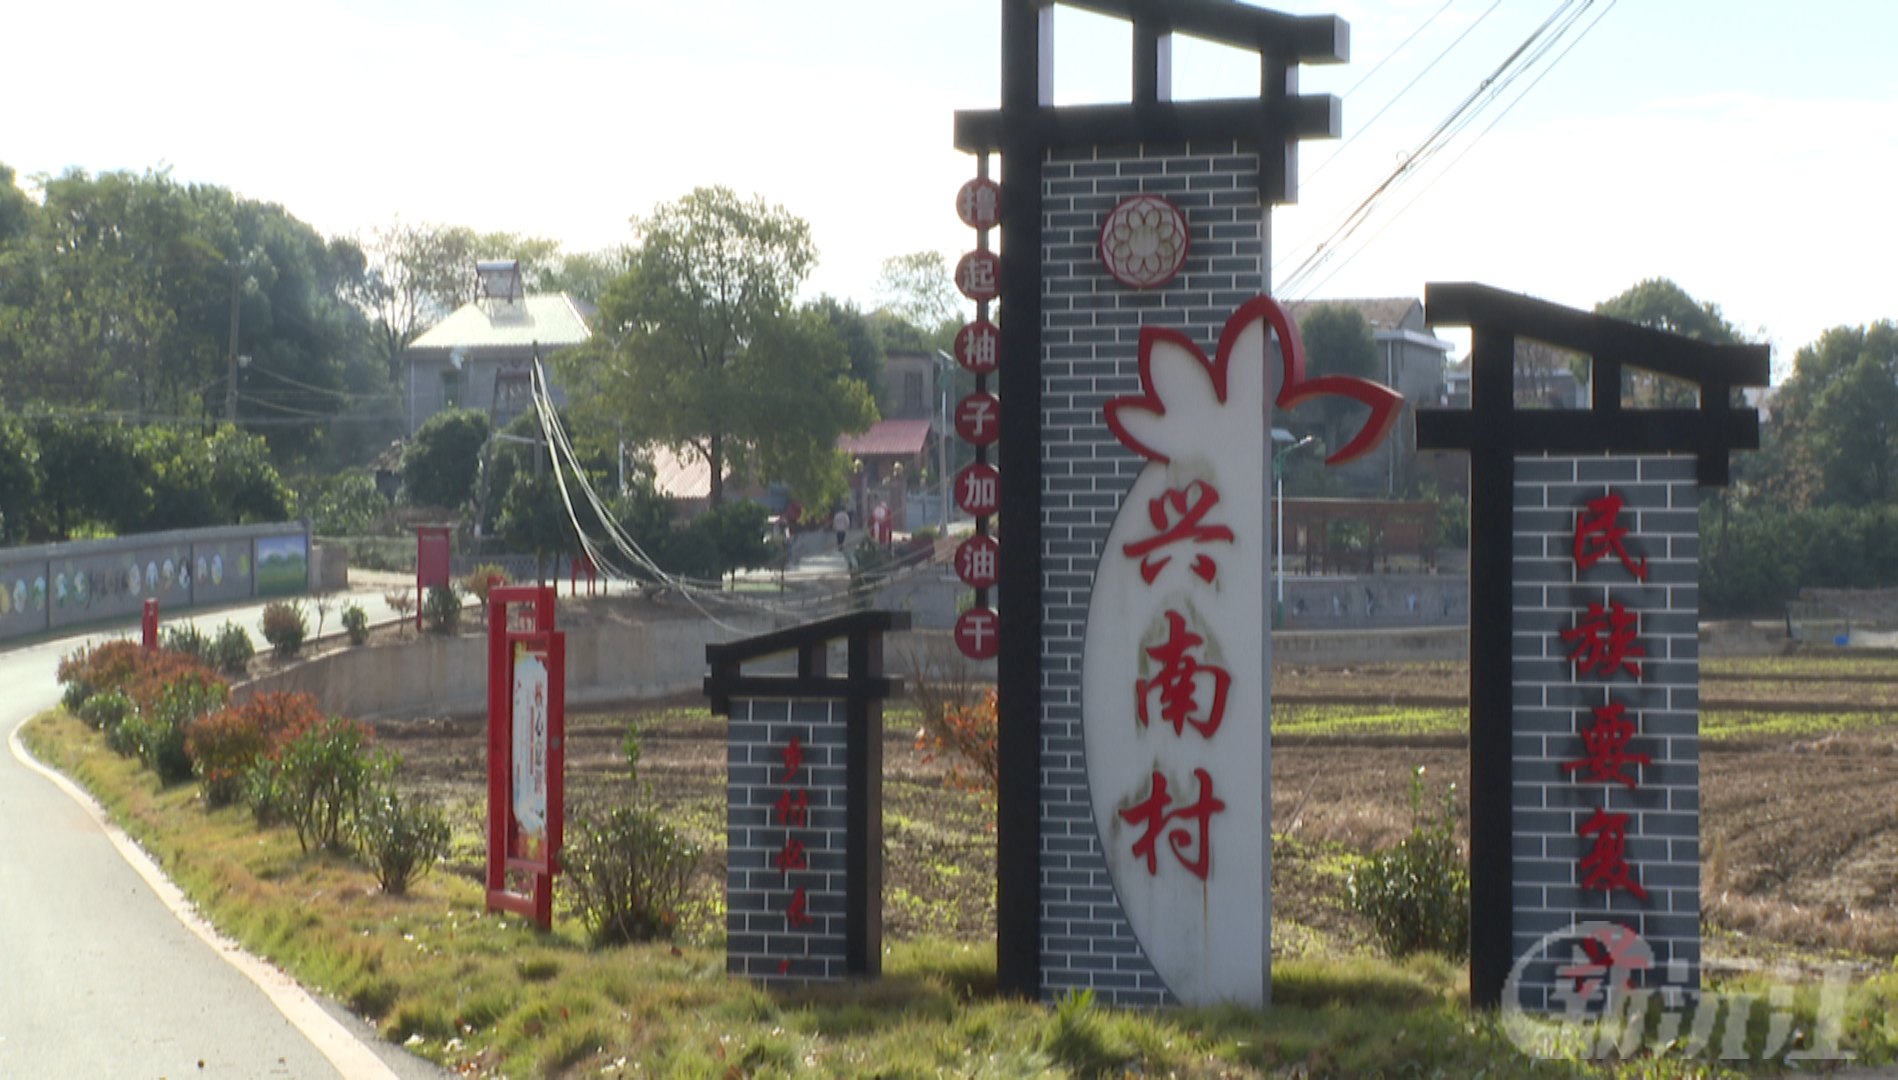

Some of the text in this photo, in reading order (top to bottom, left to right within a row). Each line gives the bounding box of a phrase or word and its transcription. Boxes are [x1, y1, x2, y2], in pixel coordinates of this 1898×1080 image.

[961, 184, 998, 652] 撸起袖子加油干
[1119, 479, 1235, 881] 兴南村
